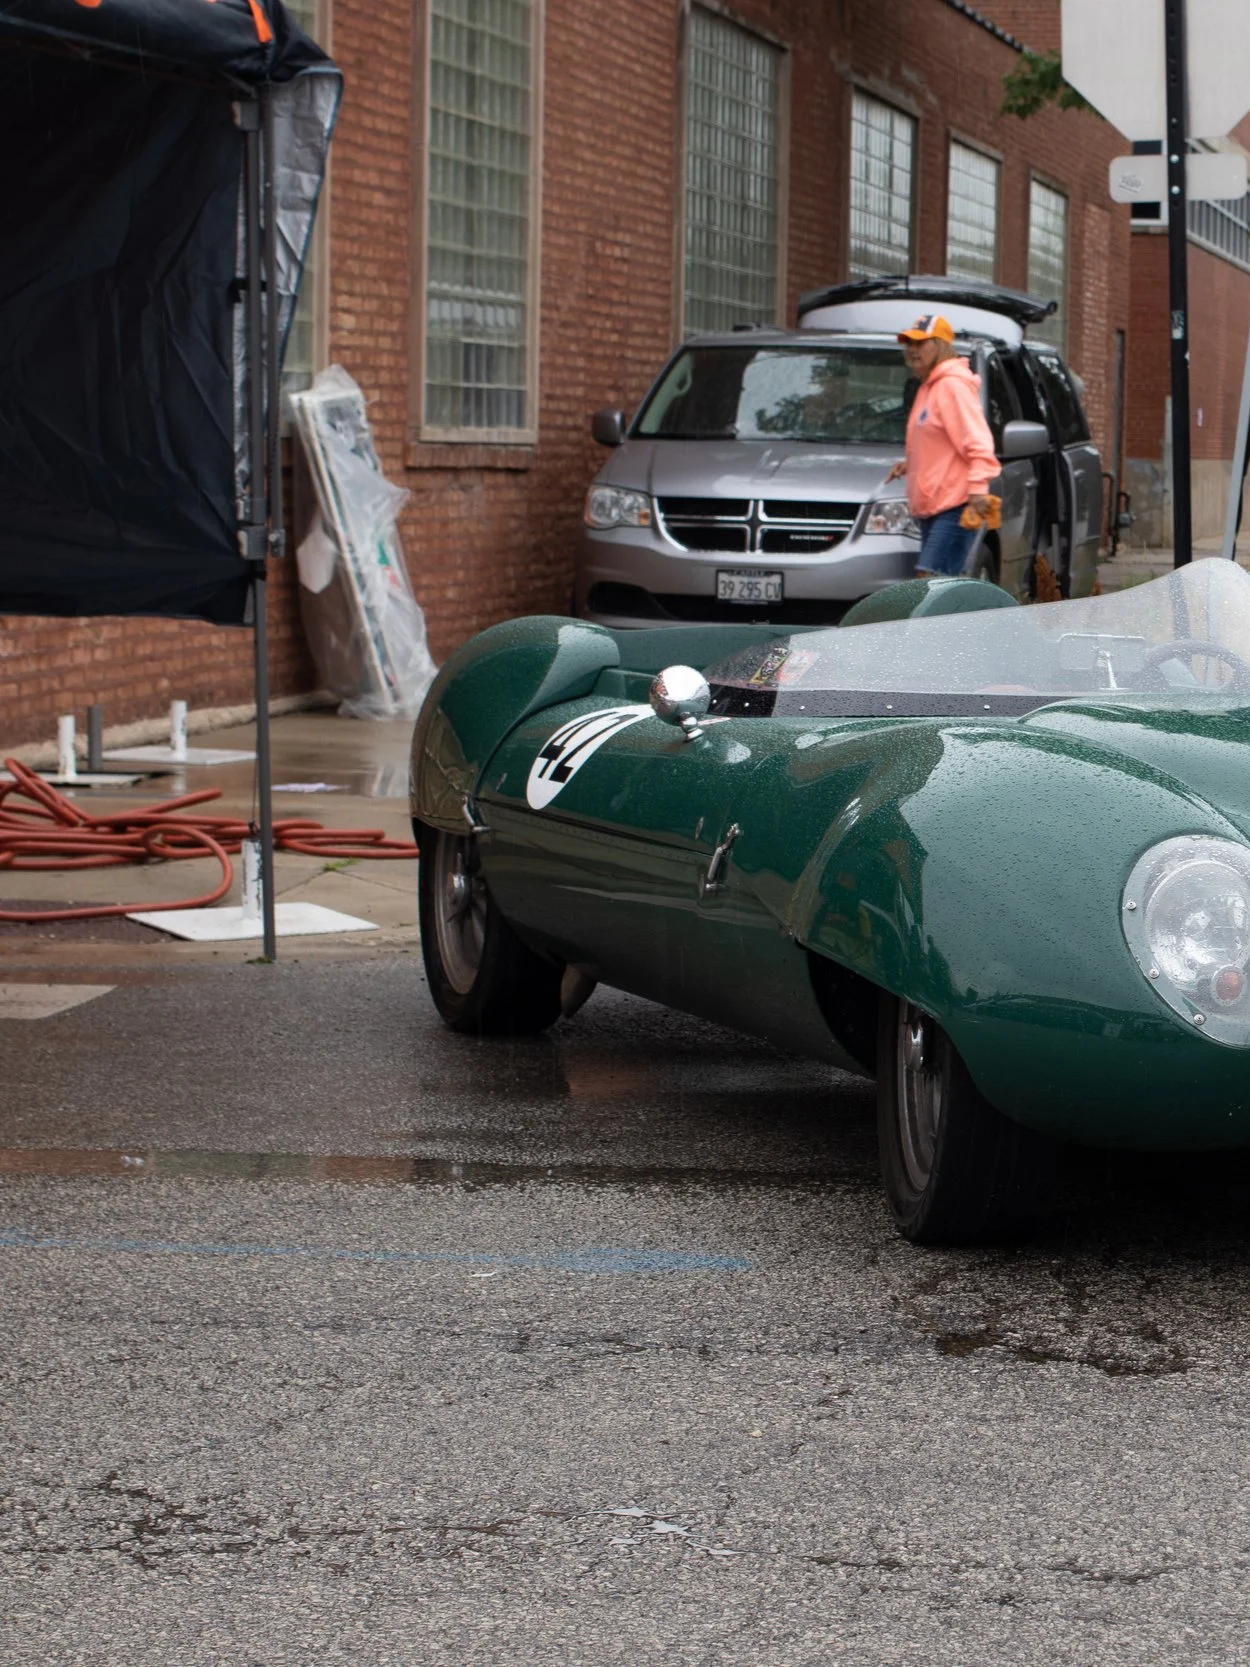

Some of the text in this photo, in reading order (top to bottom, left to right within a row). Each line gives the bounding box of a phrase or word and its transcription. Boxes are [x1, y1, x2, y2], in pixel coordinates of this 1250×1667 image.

[719, 580, 735, 597] 39
[739, 581, 762, 598] 295
[538, 711, 639, 784] 42
